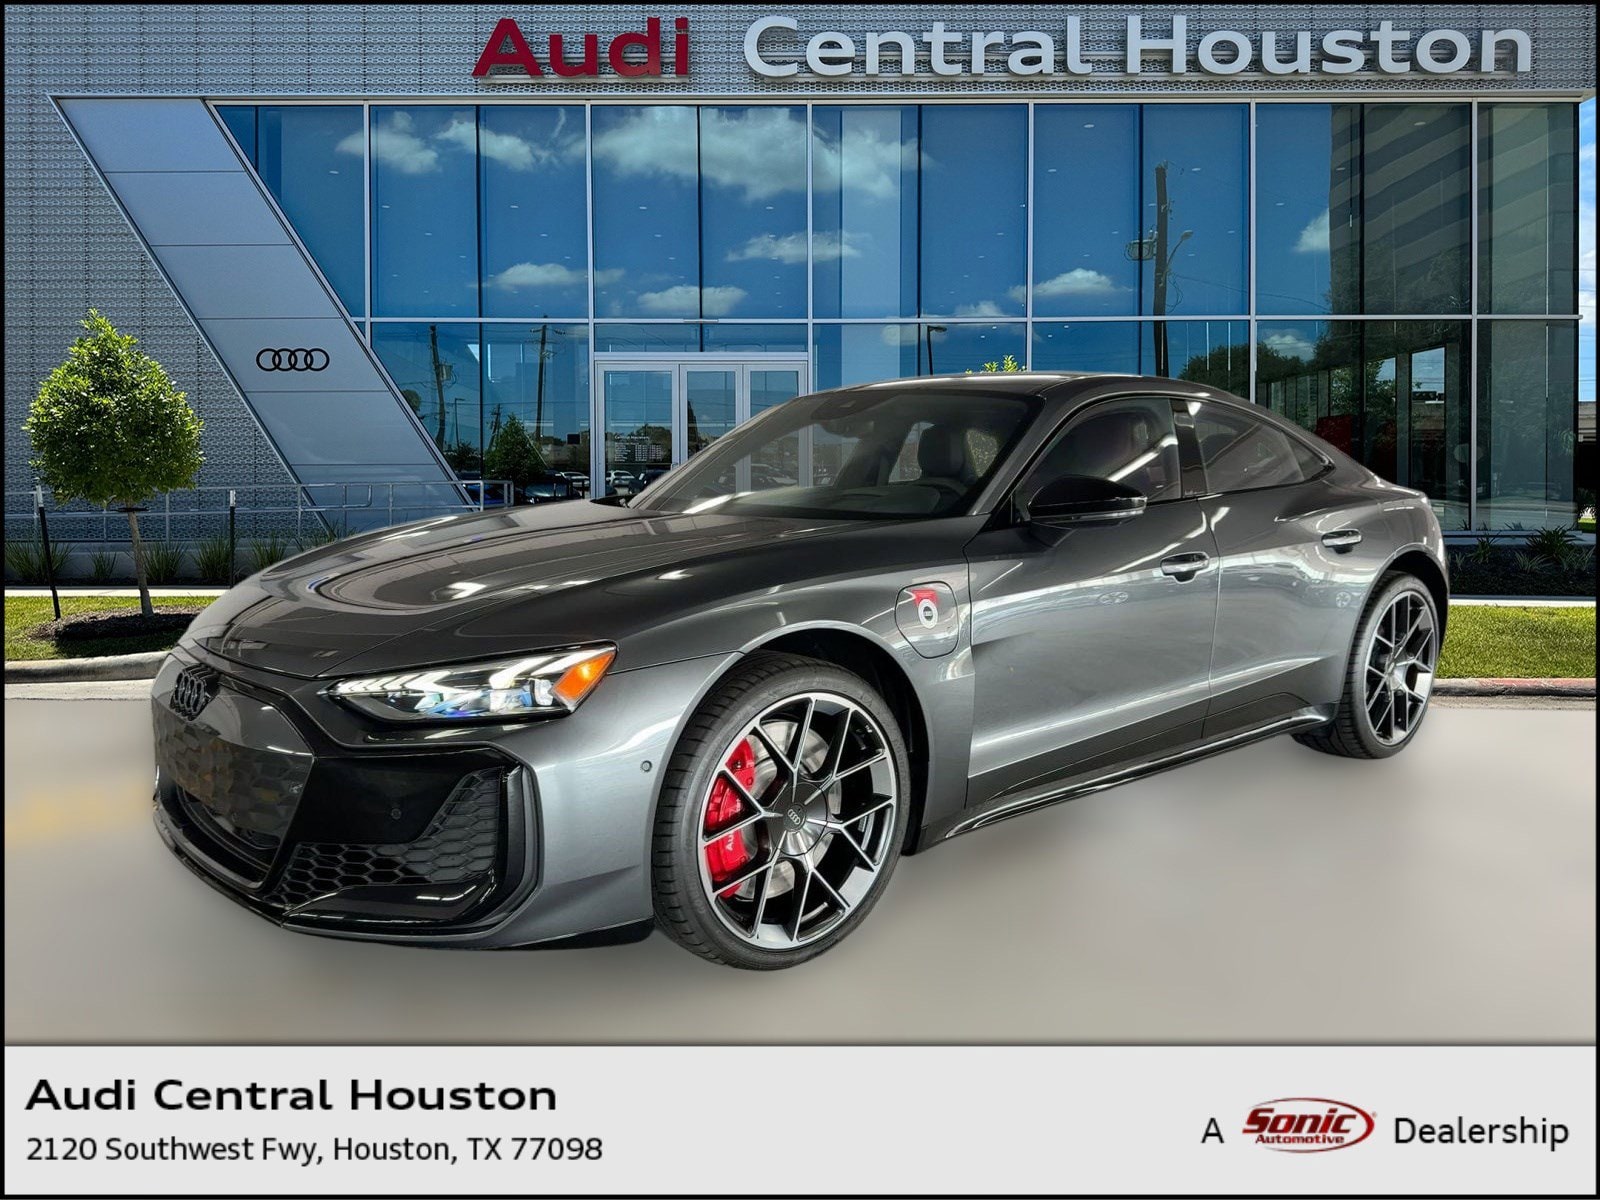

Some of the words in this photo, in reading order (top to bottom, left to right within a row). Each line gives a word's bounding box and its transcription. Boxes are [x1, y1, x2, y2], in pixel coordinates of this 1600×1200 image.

[472, 17, 690, 78] Audi
[742, 15, 1092, 77] Central
[1127, 14, 1532, 75] Houston
